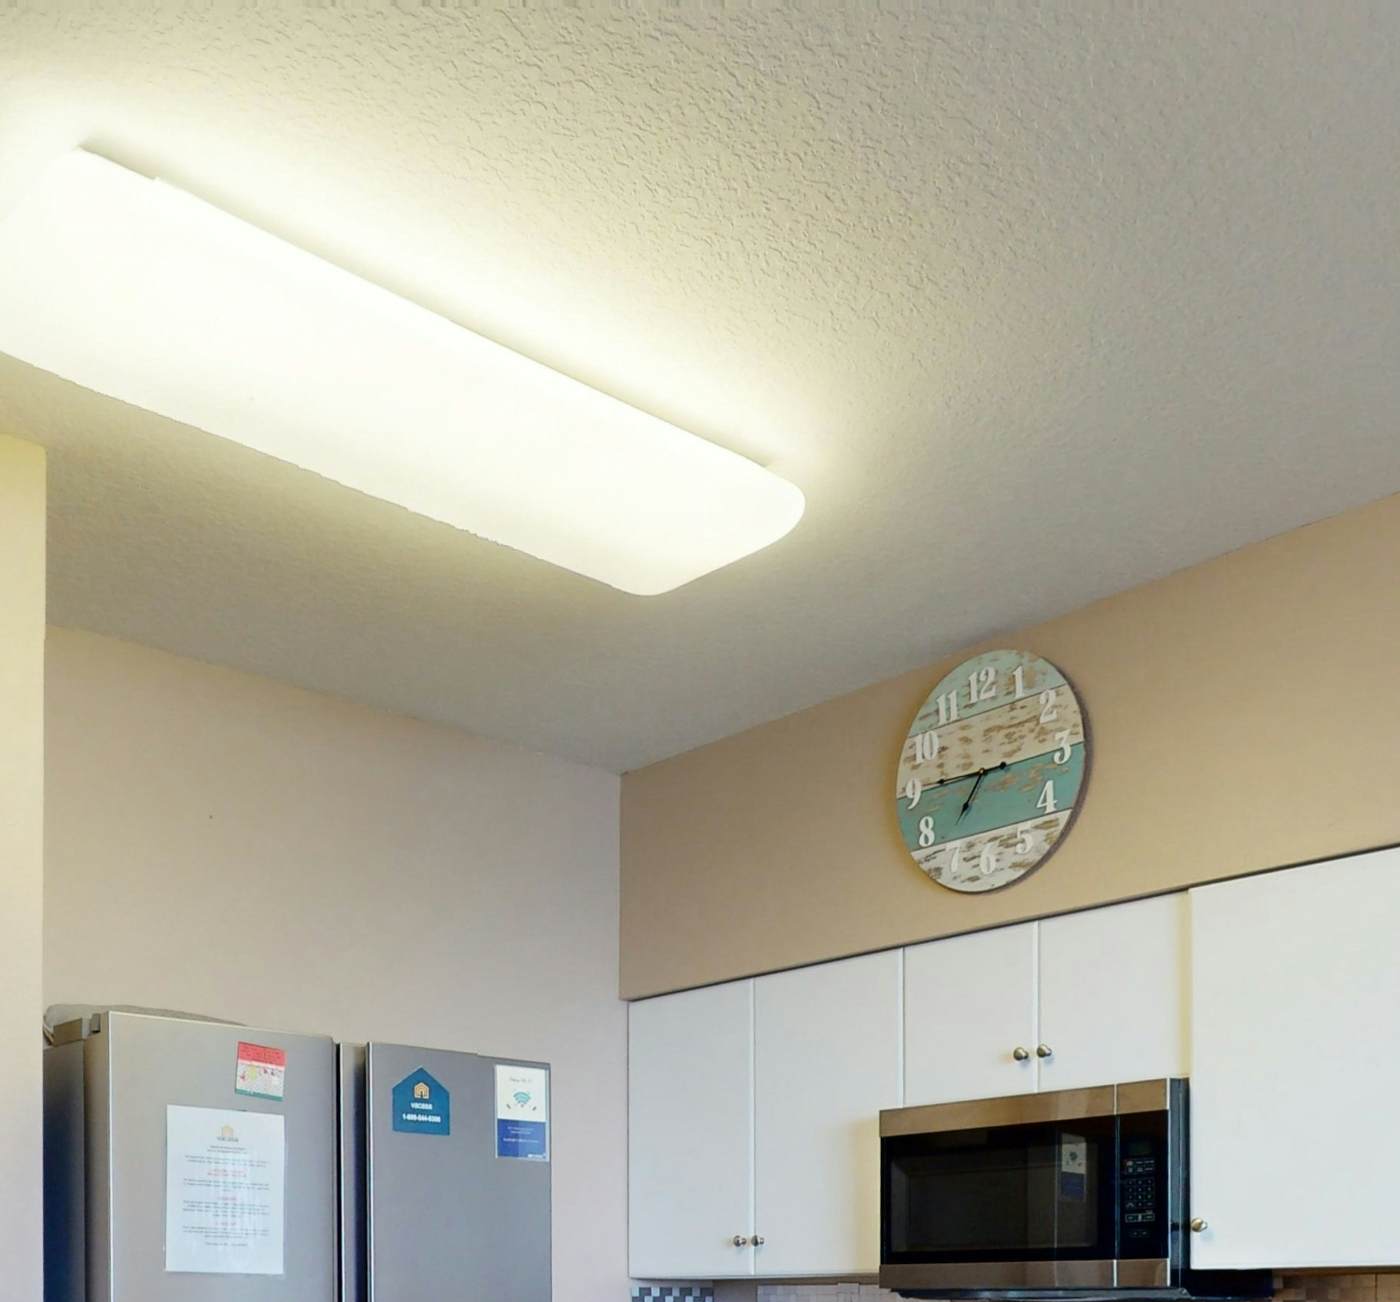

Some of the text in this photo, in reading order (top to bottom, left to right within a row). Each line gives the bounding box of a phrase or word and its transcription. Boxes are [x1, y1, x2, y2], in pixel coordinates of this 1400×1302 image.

[968, 666, 996, 704] 12
[1012, 665, 1025, 698] 1
[936, 689, 959, 725] 11
[1039, 689, 1057, 724] 2
[914, 730, 940, 764] 10
[1054, 729, 1072, 764] 3
[905, 777, 922, 810] 9
[1036, 780, 1058, 814] 4
[918, 816, 935, 847] 8
[1015, 821, 1033, 854] 5
[946, 840, 962, 873] 7
[980, 844, 996, 875] 6
